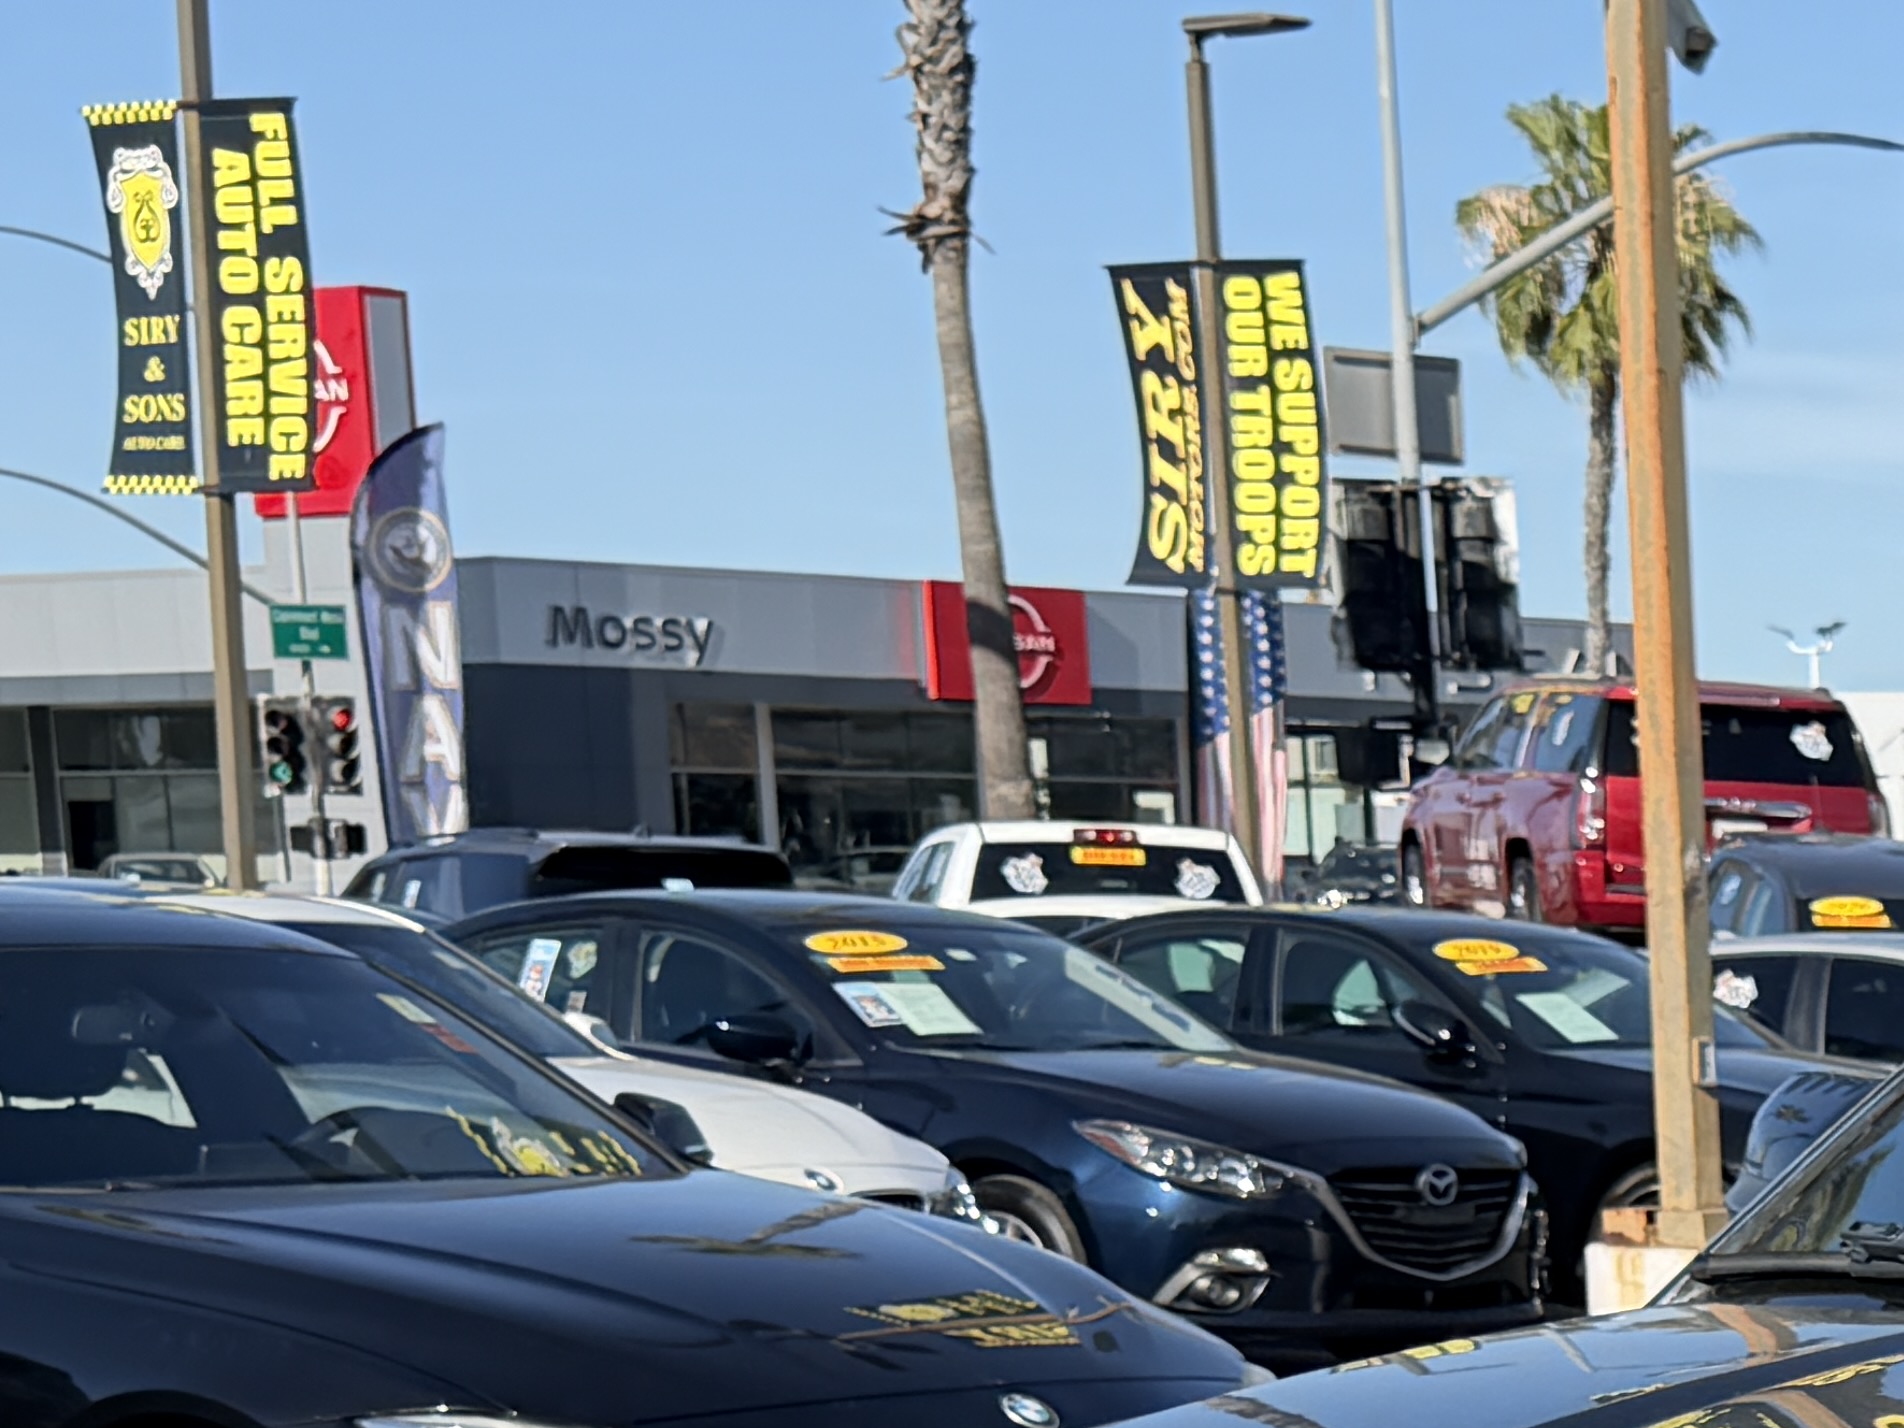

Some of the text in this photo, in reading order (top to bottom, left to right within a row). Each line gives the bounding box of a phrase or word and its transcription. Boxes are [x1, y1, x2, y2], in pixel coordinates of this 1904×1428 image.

[122, 392, 186, 424] SONS
[123, 314, 180, 346] SIRY
[143, 355, 167, 383] &
[211, 147, 265, 447] AUTO CARE
[249, 113, 308, 480] FULL SERVICE
[1120, 277, 1187, 574] SIRY
[1164, 276, 1204, 572] MOTORS.COM
[1223, 274, 1277, 577] OUR TROOPS
[1262, 271, 1321, 578] WE SUPPORT
[545, 604, 714, 668] Mossy
